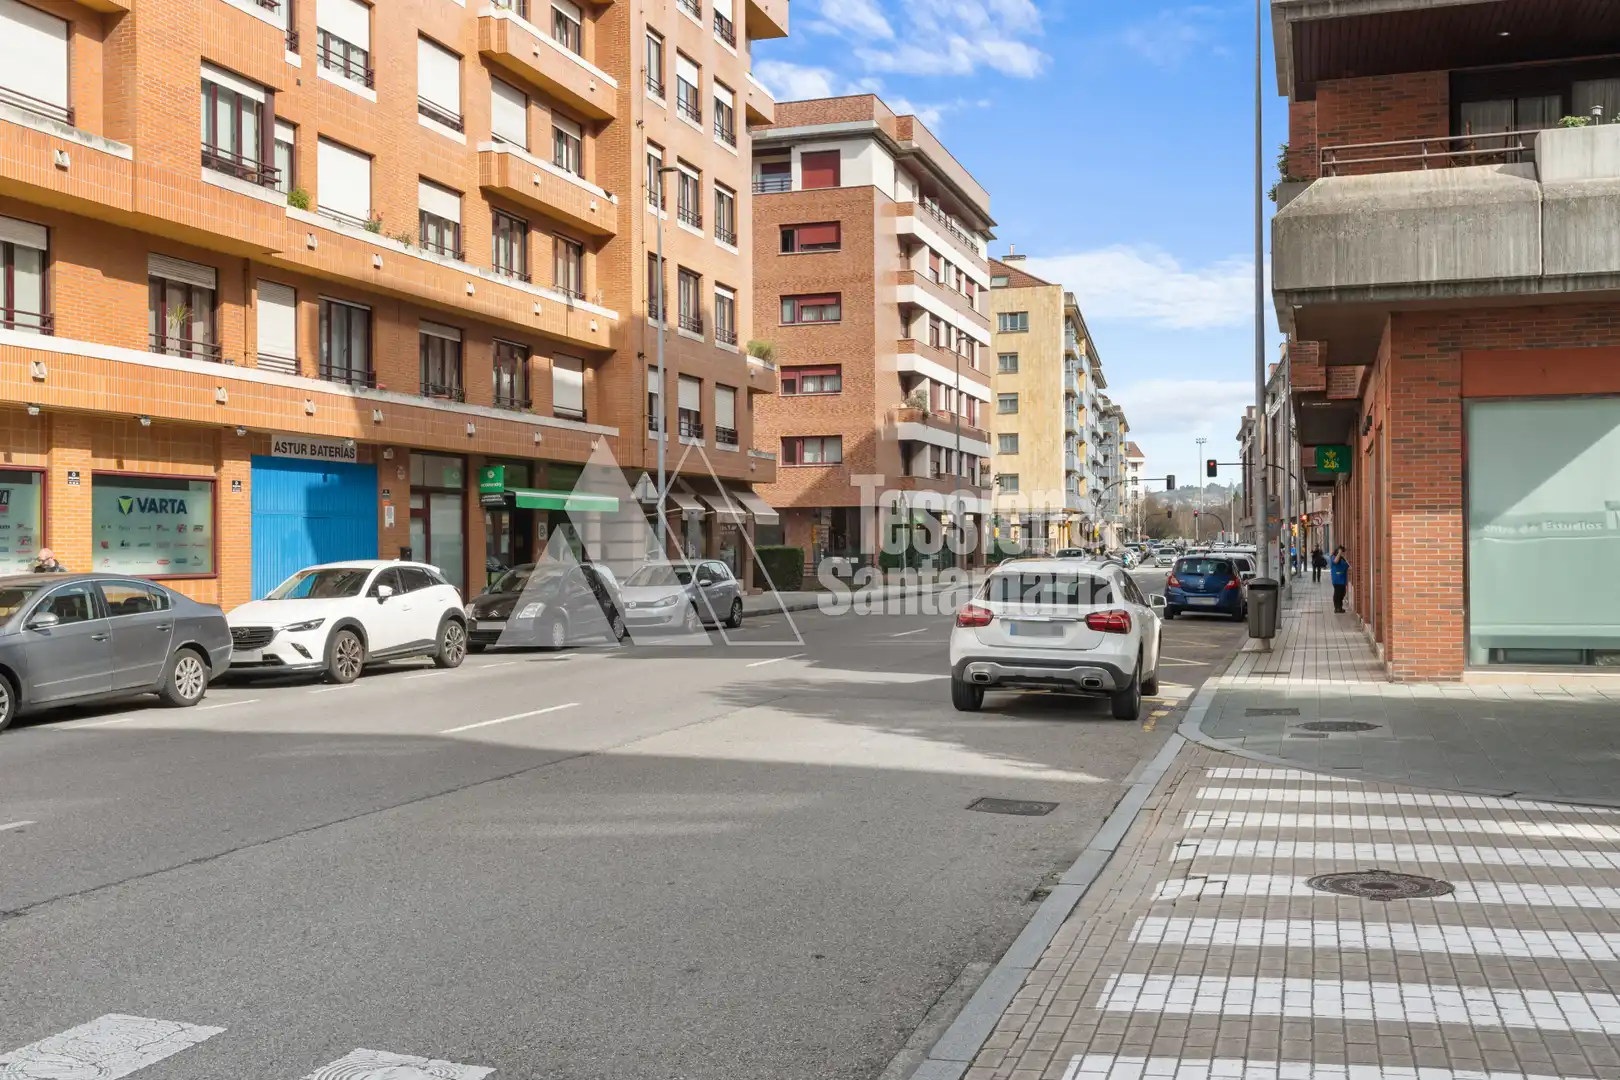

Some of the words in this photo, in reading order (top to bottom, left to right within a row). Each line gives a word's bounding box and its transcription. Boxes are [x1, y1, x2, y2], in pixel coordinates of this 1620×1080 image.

[274, 440, 307, 455] ASTUR
[136, 497, 188, 514] VARTA
[1542, 521, 1604, 531] Estudios
